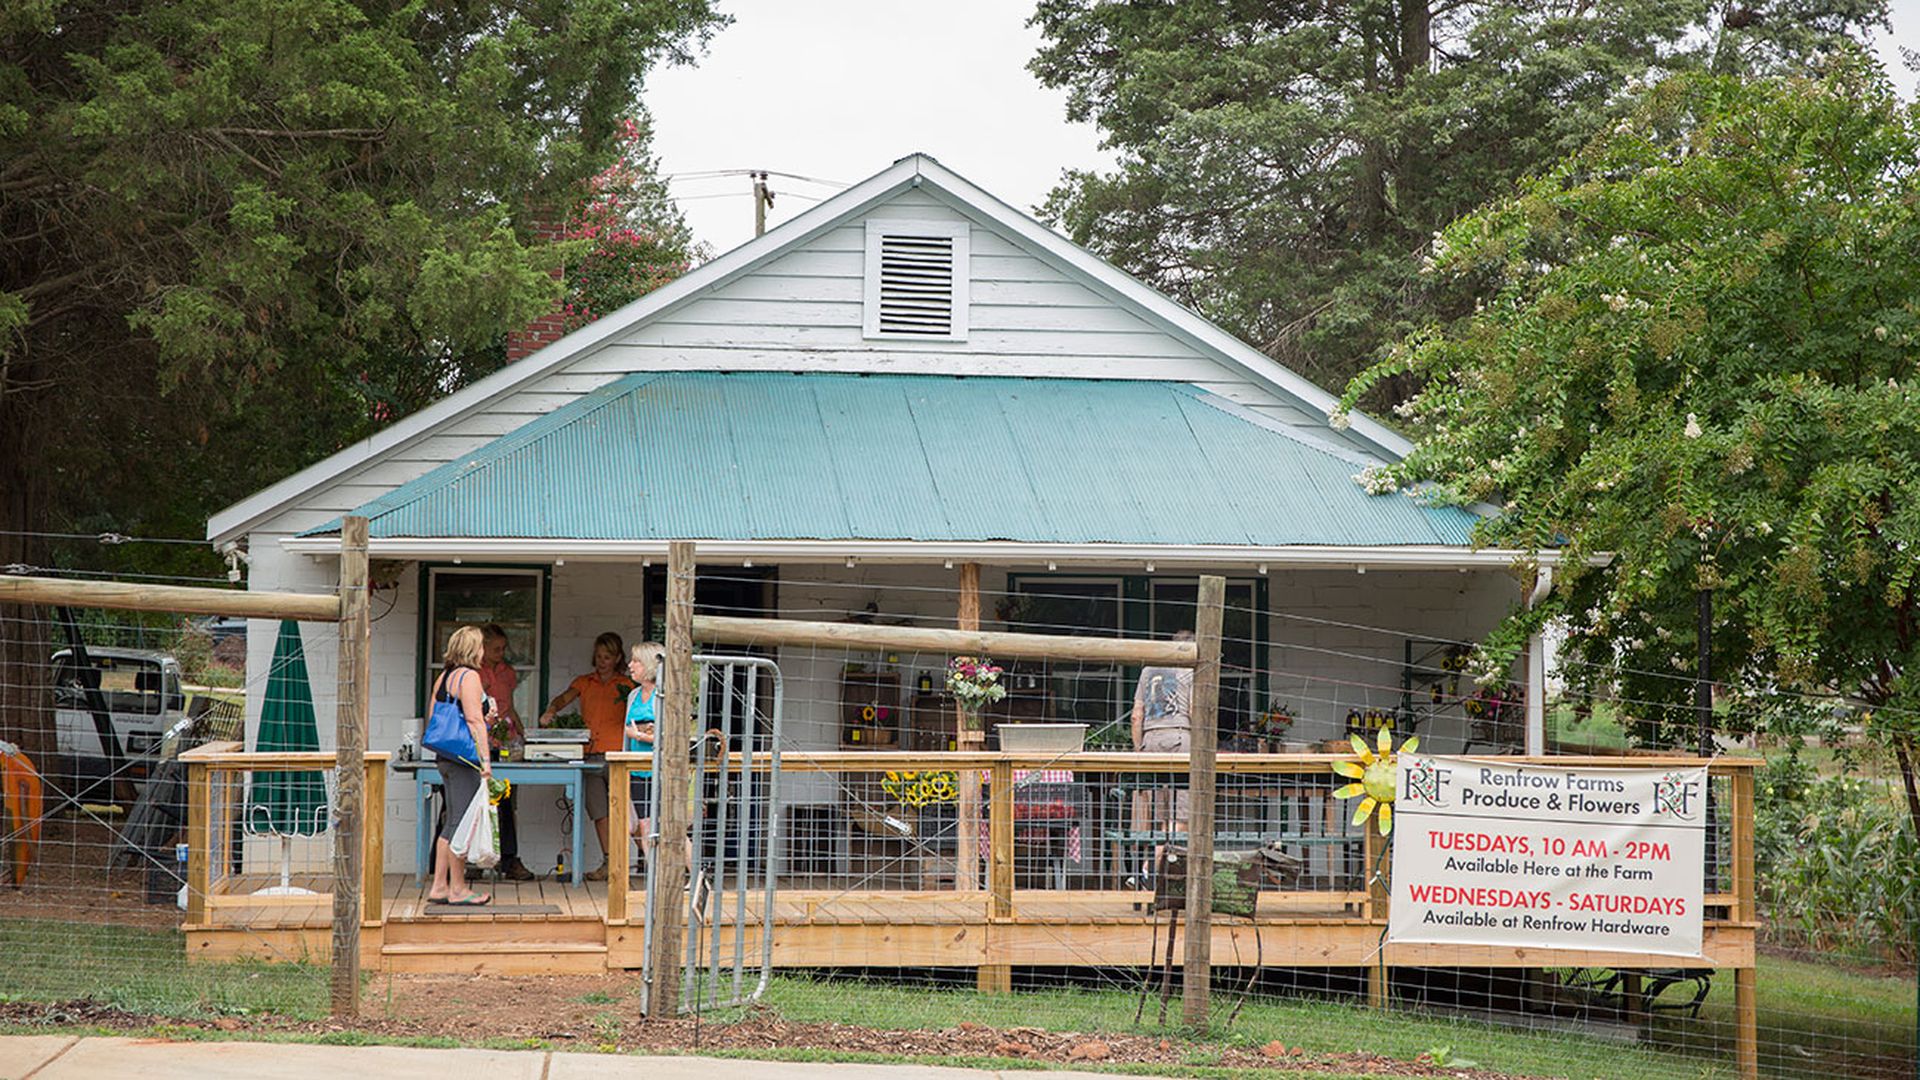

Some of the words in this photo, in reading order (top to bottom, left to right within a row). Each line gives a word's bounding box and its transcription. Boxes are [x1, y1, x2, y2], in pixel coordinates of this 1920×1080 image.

[1480, 768, 1560, 790] Renfrow
[1566, 773, 1625, 793] Farms
[1461, 788, 1542, 810] Produce
[1547, 794, 1563, 811] &
[1568, 794, 1641, 815] Flowers
[1428, 831, 1535, 858] TUESDAYS,
[1541, 837, 1565, 856] 10
[1572, 839, 1606, 858] AM
[1625, 841, 1671, 860] 2PM
[1444, 857, 1518, 874] Available
[1523, 861, 1560, 876] Here
[1565, 865, 1581, 877] at
[1585, 864, 1609, 878] the
[1614, 866, 1653, 881] Farm
[1409, 884, 1551, 910] WEDNESDAYS
[1569, 893, 1686, 916] SATURDAYS
[1423, 910, 1498, 928] Available
[1502, 915, 1518, 928] at
[1523, 914, 1587, 932] Renfrow
[1591, 919, 1670, 936] Hardware
